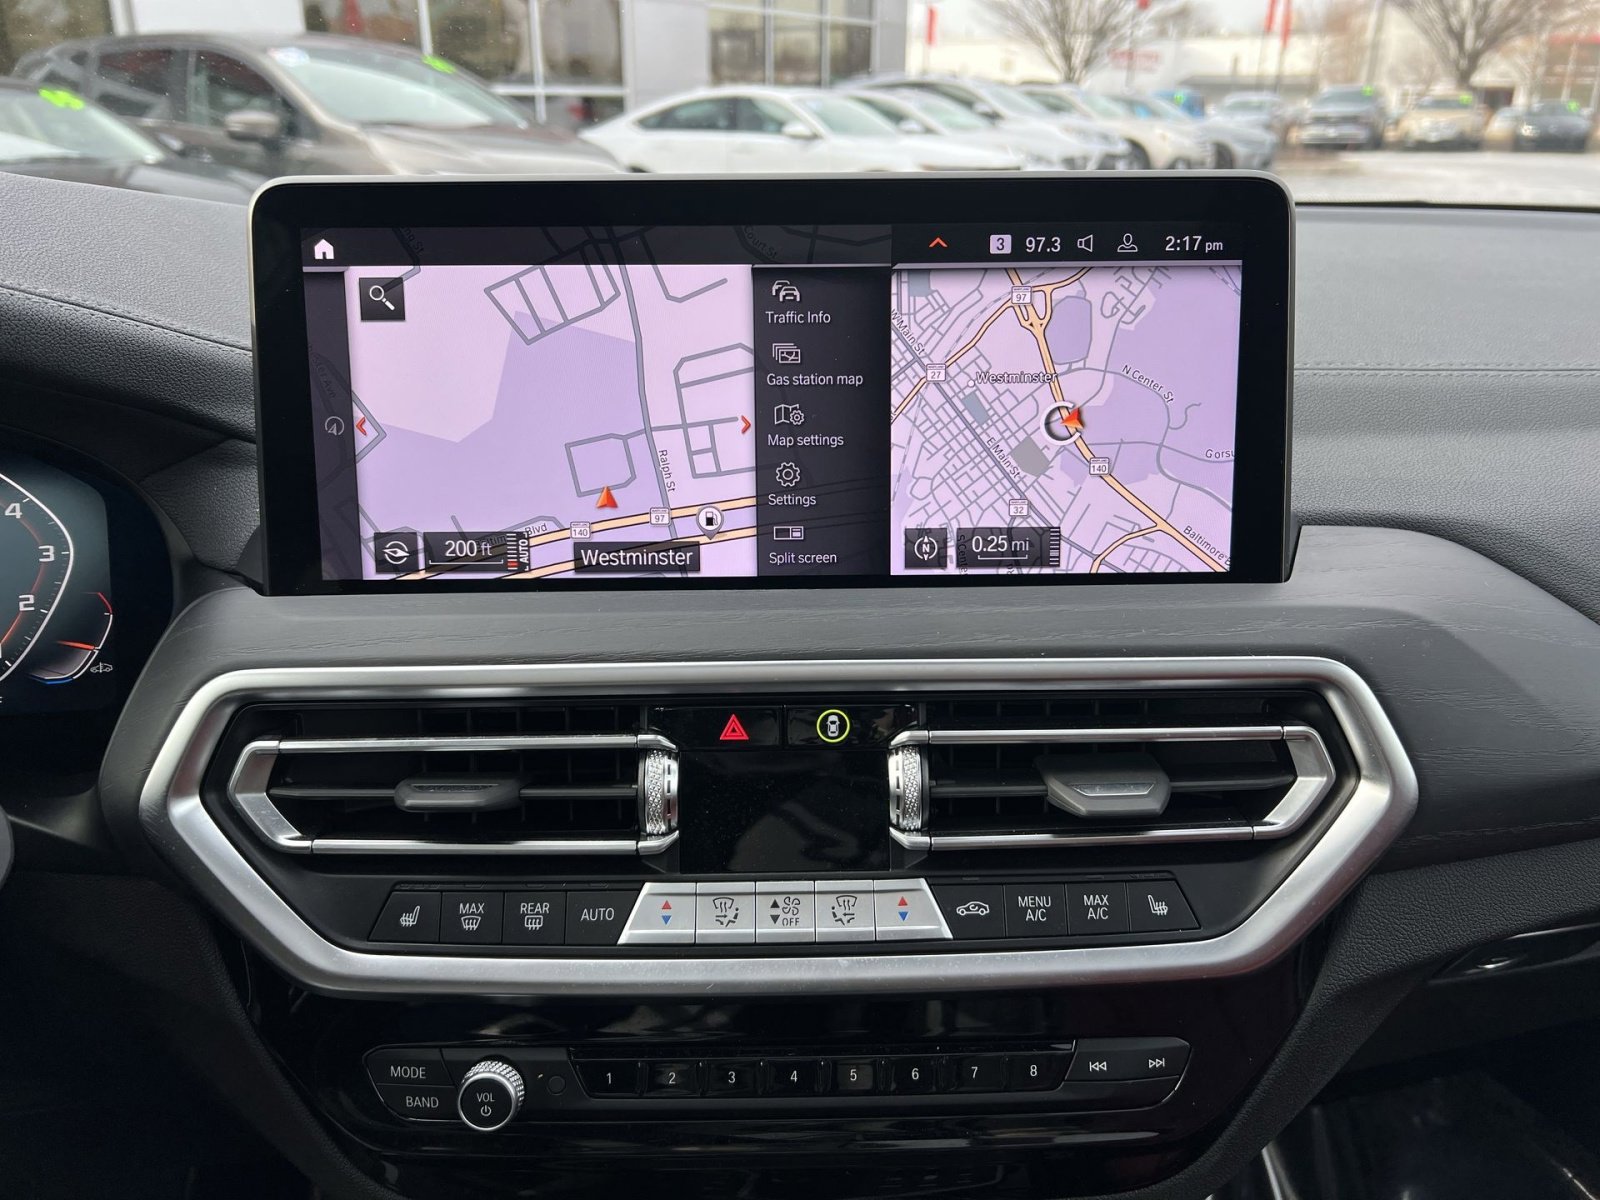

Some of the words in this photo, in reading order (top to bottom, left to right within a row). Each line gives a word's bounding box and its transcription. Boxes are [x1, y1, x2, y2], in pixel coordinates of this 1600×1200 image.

[997, 237, 1005, 251] 3
[1025, 237, 1061, 252] 97.3
[1165, 236, 1201, 251] 2:17
[1205, 241, 1224, 253] pm
[1015, 293, 1027, 302] 97
[765, 310, 804, 324] Traffic
[807, 310, 831, 324] Info
[898, 318, 917, 344] Main
[913, 341, 925, 356] St
[766, 373, 790, 386] Gas
[792, 372, 834, 386] station
[836, 375, 864, 387] map
[930, 371, 941, 380] 27
[975, 371, 1058, 384] Westminster
[1122, 364, 1132, 375] N
[1131, 370, 1164, 392] Center
[1163, 391, 1174, 404] St
[767, 434, 794, 448] Map
[796, 434, 844, 448] settings
[986, 437, 997, 447] E
[992, 444, 1013, 468] Main
[1009, 467, 1020, 480] St
[659, 449, 673, 480] Ralph
[666, 480, 676, 492] St
[1091, 464, 1107, 473] 140
[768, 493, 817, 507] Settings
[4, 502, 22, 519] 4
[1013, 506, 1024, 515] 32
[654, 515, 665, 523] 97
[525, 523, 548, 536] Blvd
[572, 528, 588, 537] 140
[445, 540, 477, 557] 200
[481, 543, 493, 556] ft
[922, 543, 930, 552] N
[971, 535, 1008, 552] 0.25
[1011, 537, 1030, 552] mi
[1183, 525, 1225, 561] Baltimore
[38, 545, 55, 562] 3
[519, 539, 529, 563] AUTO
[581, 549, 693, 566] Westminster
[769, 552, 796, 566] Split
[798, 553, 837, 564] screen
[18, 594, 35, 611] 2
[1017, 896, 1052, 908] MENU
[1083, 894, 1109, 906] MAX
[459, 902, 485, 914] MAX
[520, 902, 550, 914] REAR
[580, 907, 615, 921] AUTO
[1025, 908, 1047, 921] A/C
[1087, 907, 1109, 920] A/C
[782, 917, 800, 927] OFF
[390, 1065, 427, 1079] MODE
[728, 1071, 736, 1083] 3
[790, 1070, 798, 1082] 4
[849, 1069, 857, 1081] 5
[911, 1067, 920, 1080] 6
[971, 1066, 978, 1078] 7
[1029, 1064, 1038, 1077] 8
[605, 1072, 612, 1084] 1
[668, 1072, 676, 1084] 2
[405, 1095, 439, 1109] BAND
[476, 1092, 496, 1102] VOL
